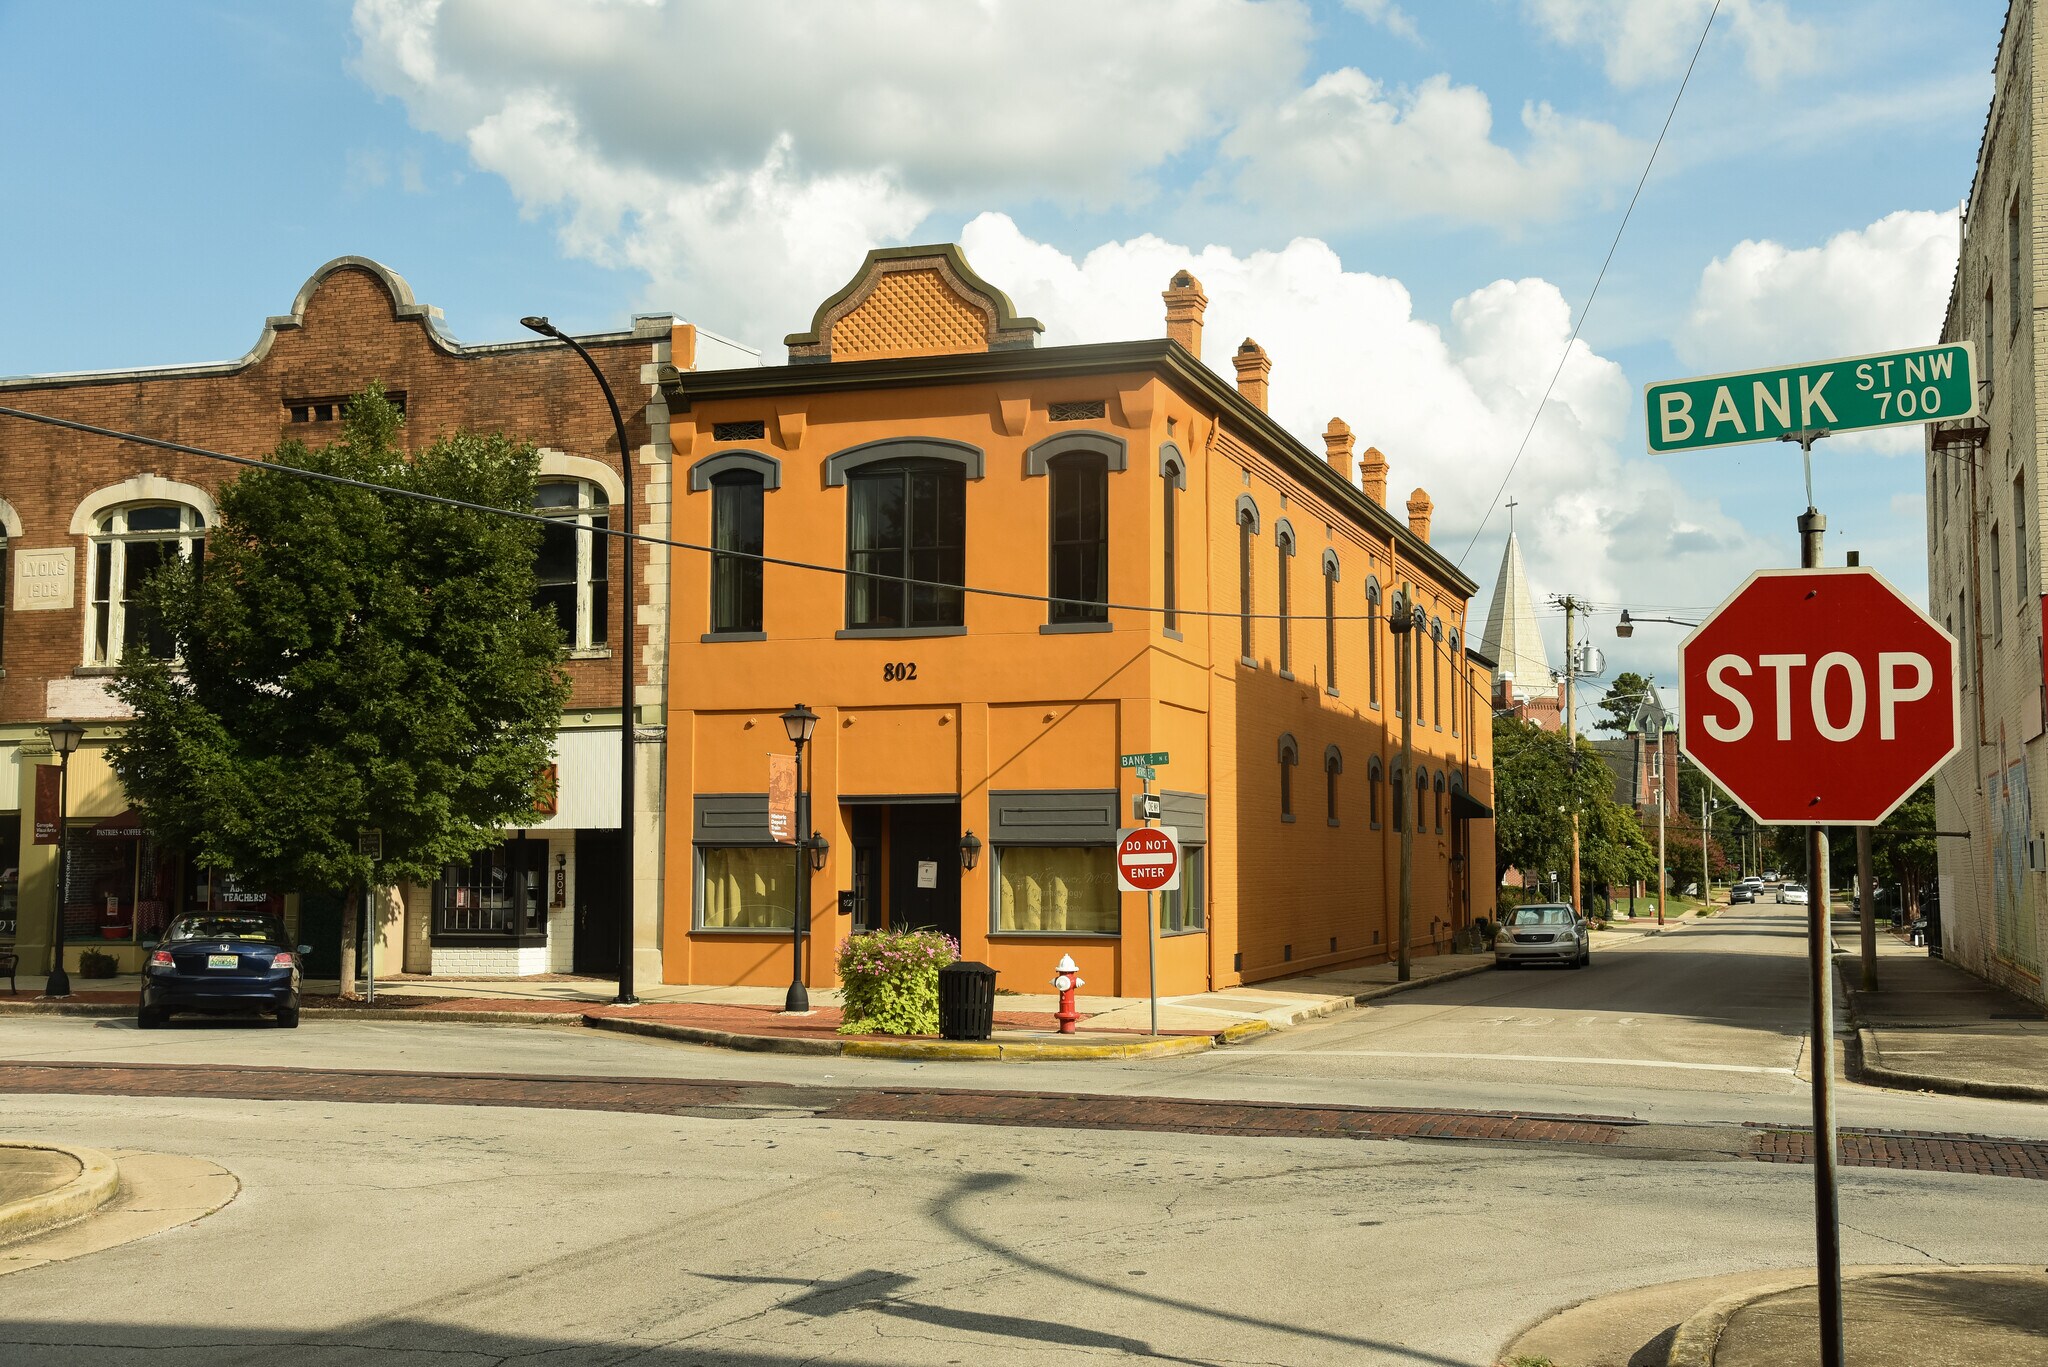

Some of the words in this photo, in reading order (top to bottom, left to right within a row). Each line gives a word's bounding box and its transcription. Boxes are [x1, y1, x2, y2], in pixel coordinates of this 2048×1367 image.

[1659, 371, 1838, 443] BANK
[1856, 360, 1895, 391] ST
[1904, 352, 1953, 384] NW
[1872, 386, 1941, 419] 700
[22, 561, 67, 578] LYONS
[28, 582, 60, 598] 1903
[883, 662, 917, 682] 802
[1702, 651, 1933, 743] STOP
[1122, 755, 1146, 767] BANK
[1126, 840, 1141, 851] DO
[1145, 840, 1168, 850] NOT
[1131, 867, 1165, 878] ENTER
[556, 872, 564, 896] 804
[223, 893, 267, 902] TEACHERS!
